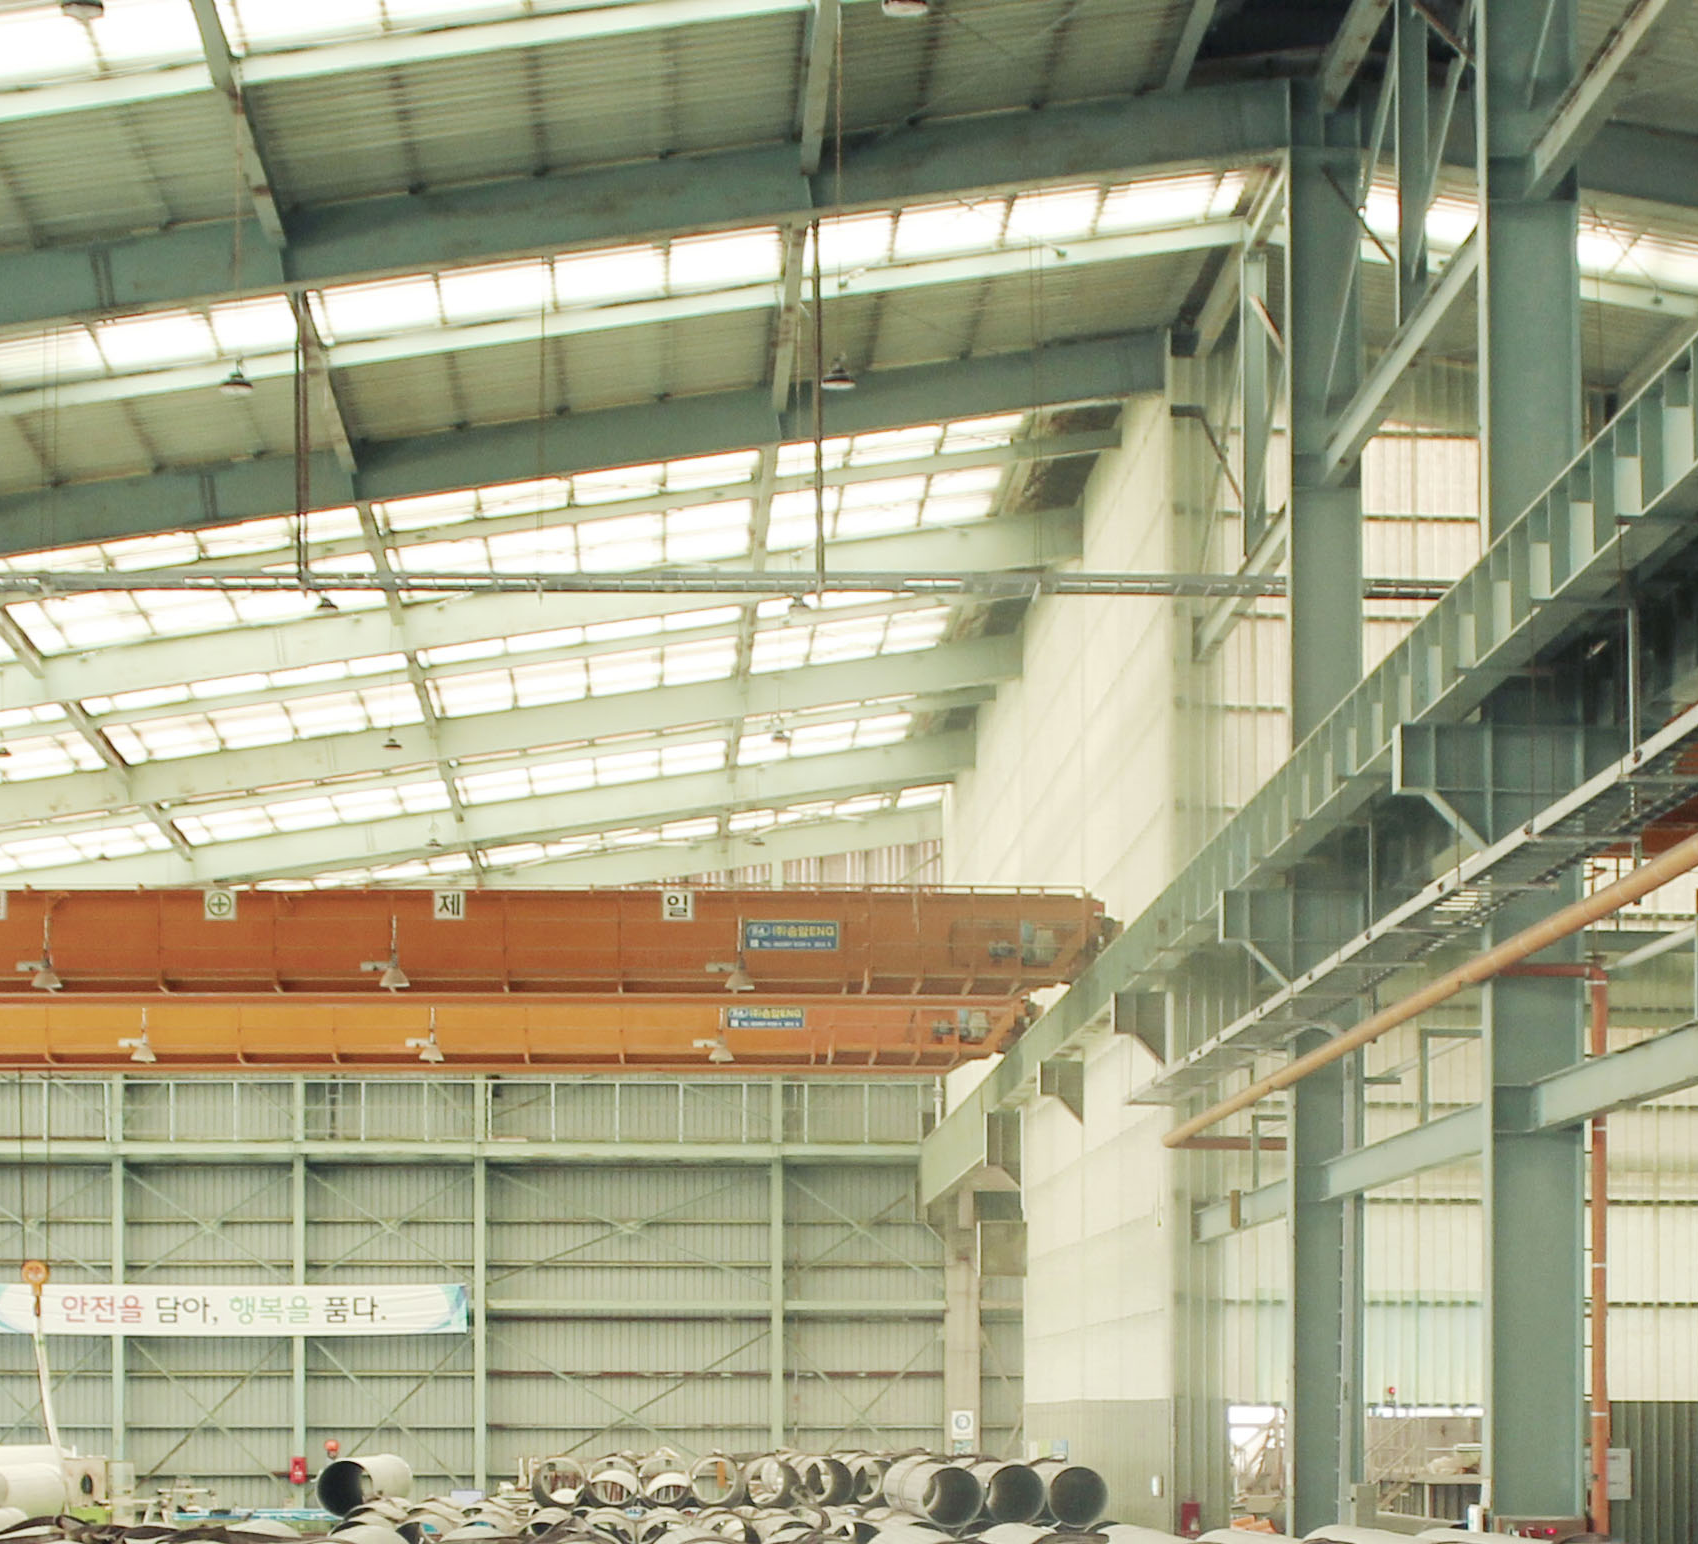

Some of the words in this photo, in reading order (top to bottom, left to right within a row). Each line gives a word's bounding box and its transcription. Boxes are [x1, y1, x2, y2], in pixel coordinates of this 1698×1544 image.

[438, 893, 460, 916] 제
[667, 894, 688, 917] 일
[60, 1295, 145, 1324] 안전을
[155, 1294, 220, 1325] 담아,
[229, 1295, 314, 1324] 행복을
[322, 1295, 388, 1324] 품다.
